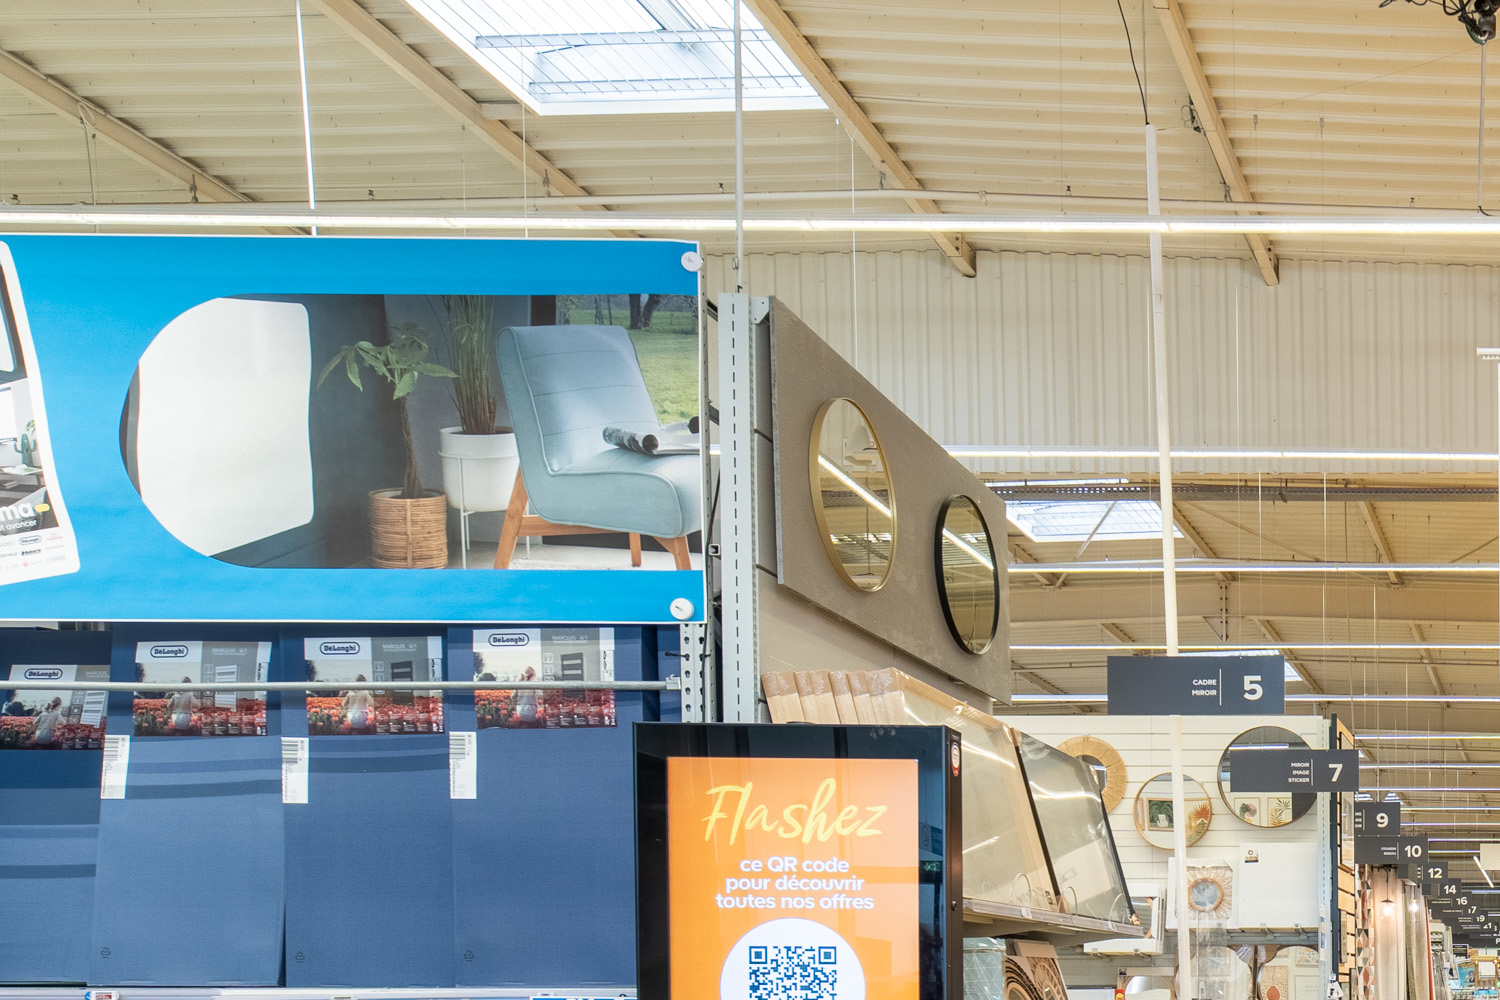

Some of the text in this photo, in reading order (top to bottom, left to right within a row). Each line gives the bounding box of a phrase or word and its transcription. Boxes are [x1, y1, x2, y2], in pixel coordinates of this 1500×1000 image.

[1243, 675, 1263, 701] 5
[1328, 763, 1343, 782] 7
[702, 778, 888, 846] Flashez
[1376, 812, 1389, 828] 9
[1404, 845, 1422, 858] 10
[739, 856, 850, 873] ce QR code
[1428, 868, 1443, 879] 12
[725, 875, 864, 893] pour découvrir
[1443, 884, 1457, 895] 14
[715, 894, 875, 910] toutes nos offres
[1456, 897, 1468, 905] 16
